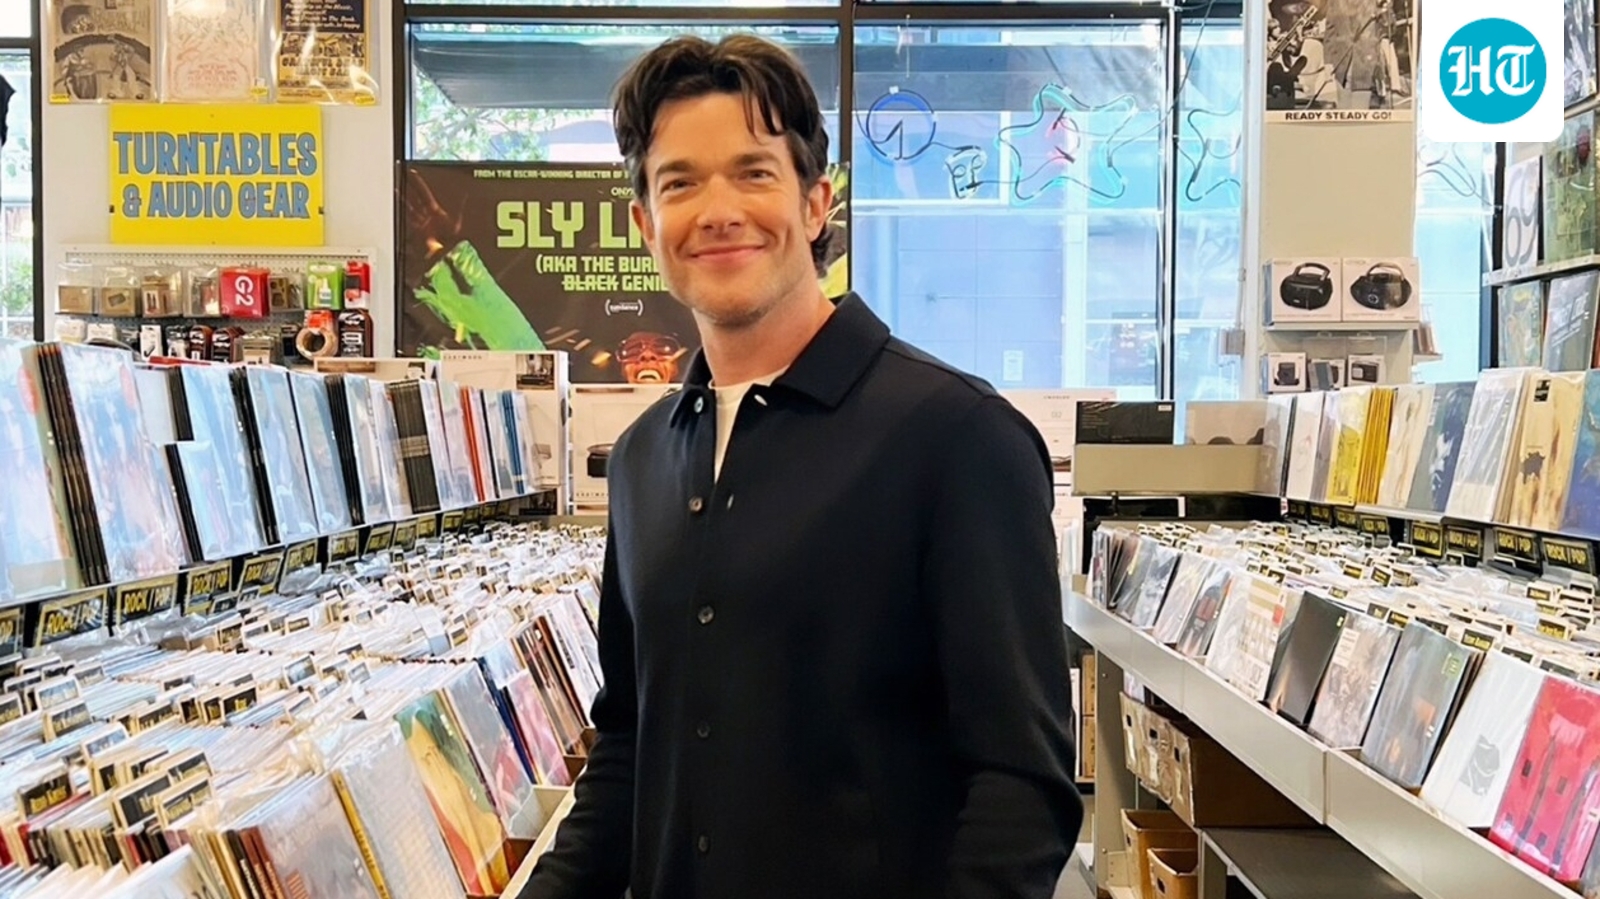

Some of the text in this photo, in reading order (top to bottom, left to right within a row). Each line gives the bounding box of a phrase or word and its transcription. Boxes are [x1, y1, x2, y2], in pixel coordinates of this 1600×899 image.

[1285, 111, 1392, 121] READY STEADY GO!
[112, 131, 317, 176] TURNTABLES
[473, 169, 496, 179] FROM
[497, 169, 512, 179] THE
[513, 169, 574, 179] OSCAR-WINNING
[575, 170, 612, 179] DIRECTOR
[613, 170, 623, 179] OF
[122, 181, 310, 219] & AUDIO GEAR
[497, 201, 642, 249] SLY LI
[535, 253, 578, 274] (AKA
[580, 255, 615, 273] THE
[234, 275, 254, 307] G2
[561, 274, 620, 292] BLACK
[1546, 543, 1566, 562] ROCK
[1571, 547, 1586, 564] POP
[124, 590, 148, 614] ROCK
[154, 586, 171, 607] POP
